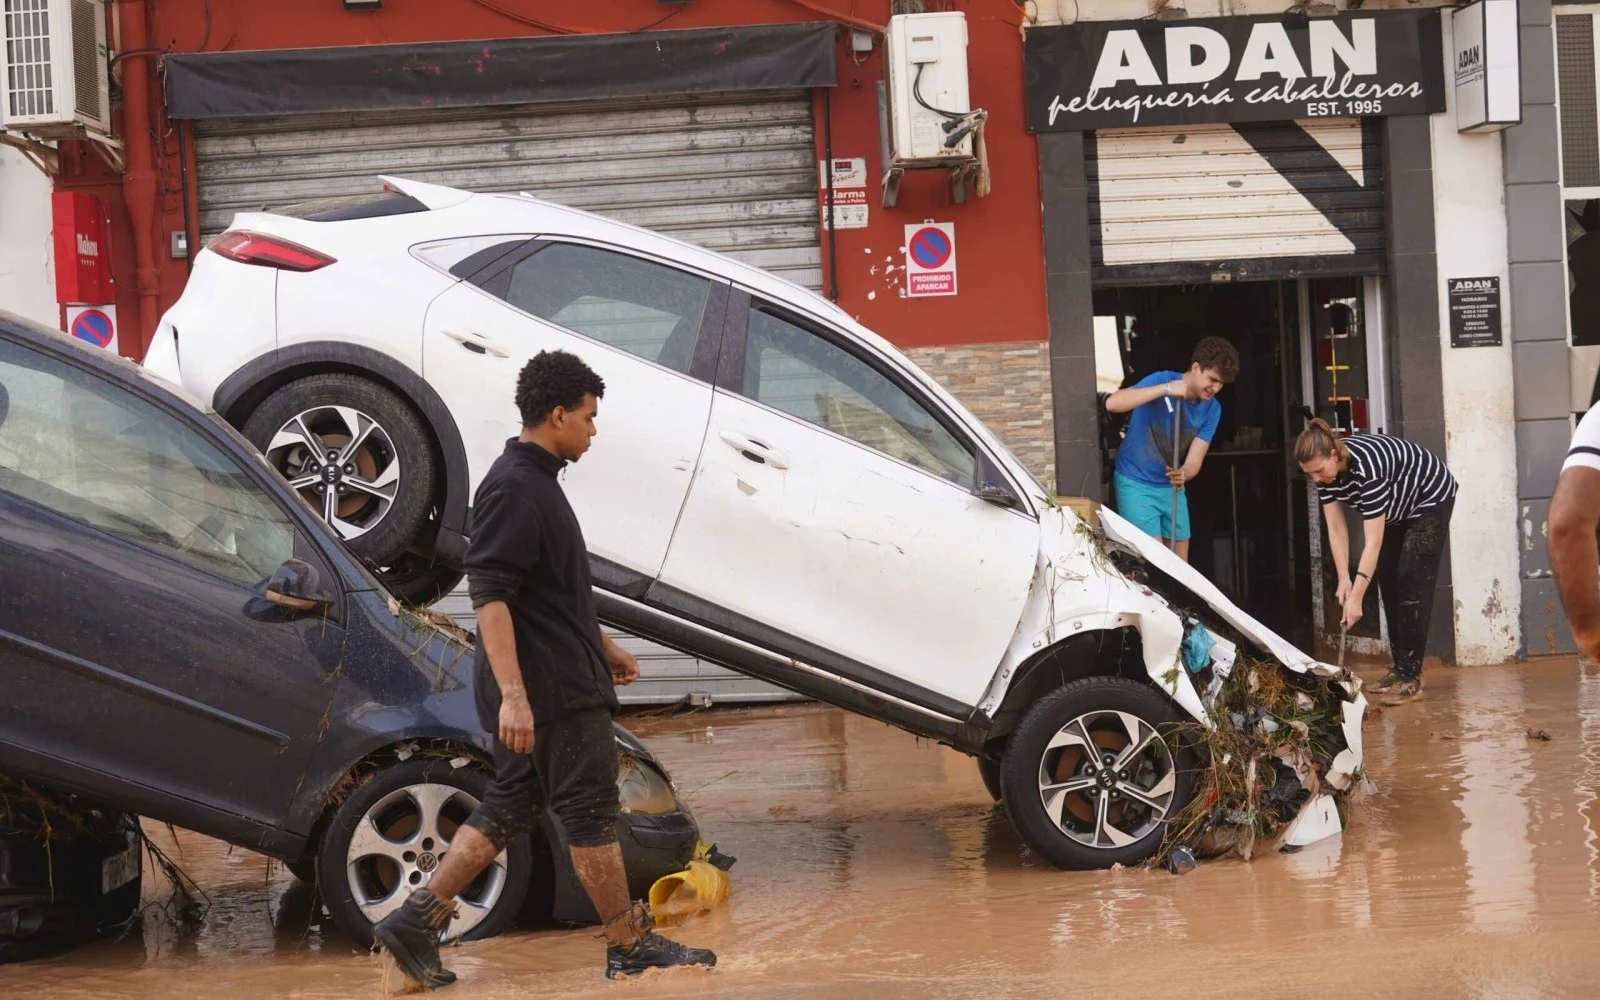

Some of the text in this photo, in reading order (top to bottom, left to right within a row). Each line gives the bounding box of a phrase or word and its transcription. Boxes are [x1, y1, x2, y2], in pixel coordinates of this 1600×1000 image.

[1090, 18, 1378, 89] ADAN
[1459, 45, 1480, 70] ADAN
[1048, 71, 1423, 126] peluquería caballeros
[1306, 100, 1382, 117] EST. 1995
[912, 274, 951, 283] PROHIBIDO
[1455, 280, 1492, 289] ADAN
[916, 283, 949, 291] APARCAR
[1101, 771, 1113, 787] KIA
